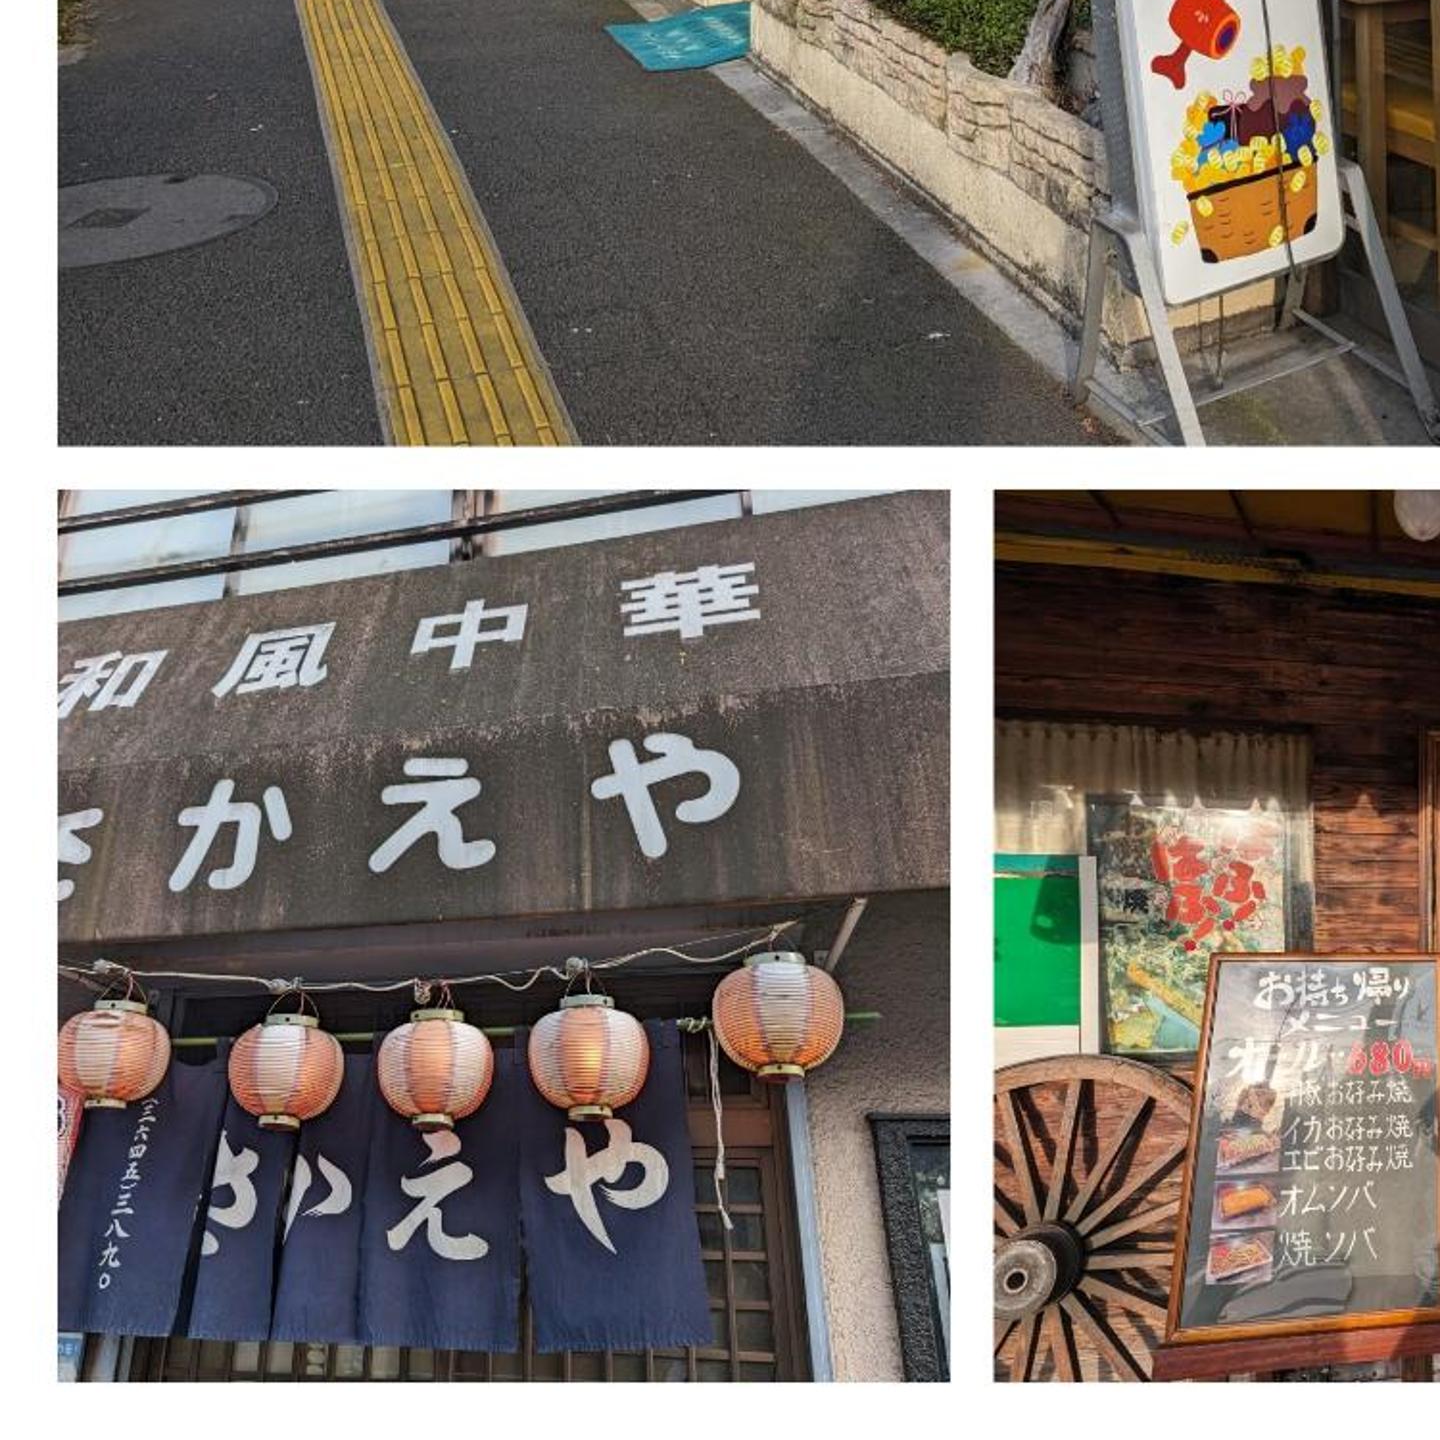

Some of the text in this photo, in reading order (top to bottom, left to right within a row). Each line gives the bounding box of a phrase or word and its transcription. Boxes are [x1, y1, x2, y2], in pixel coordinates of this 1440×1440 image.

[57, 562, 761, 719] 和風中華
[1254, 966, 1410, 1009] お持ち帰り
[1281, 1012, 1398, 1037] メニュー
[1284, 1114, 1414, 1142] イカお好み焼
[1283, 1145, 1414, 1173] エビお好み焼
[1280, 1184, 1377, 1217] オムソバ
[1279, 1227, 1378, 1267] 焼ソバ
